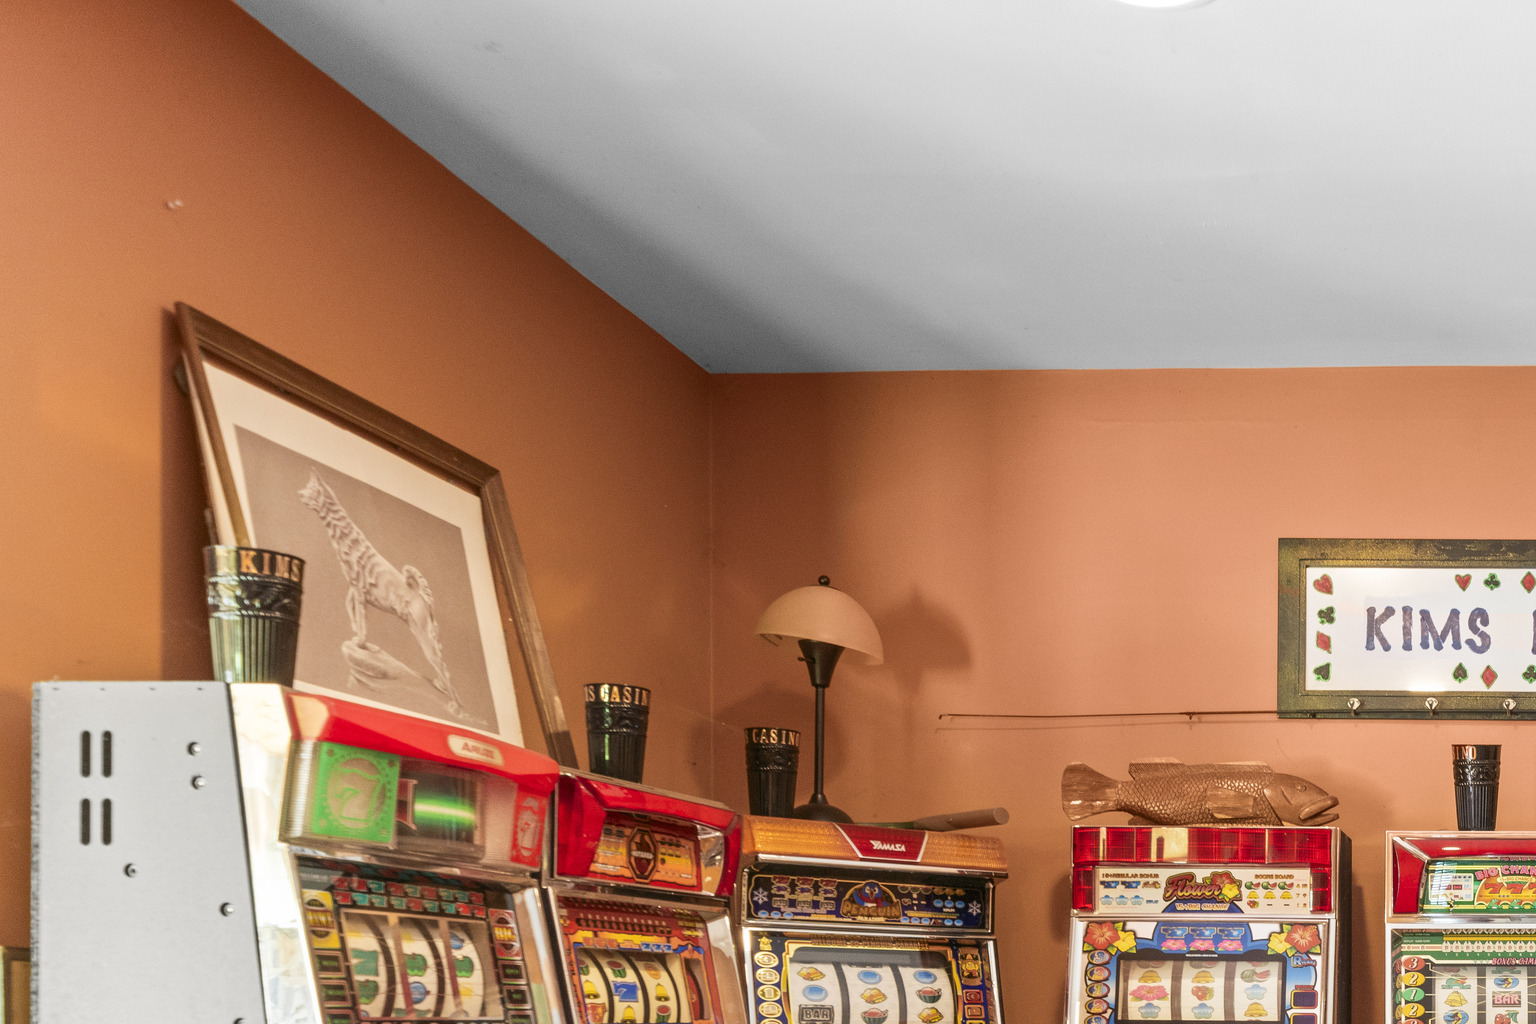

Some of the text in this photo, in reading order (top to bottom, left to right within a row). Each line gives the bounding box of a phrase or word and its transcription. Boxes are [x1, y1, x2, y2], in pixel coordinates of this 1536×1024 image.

[240, 550, 301, 582] KIMS
[1365, 605, 1492, 654] KIMS
[1474, 867, 1499, 881] BIG
[1165, 873, 1222, 898] Flower
[1408, 957, 1418, 969] 3
[1491, 957, 1517, 965] BONUS
[1409, 973, 1419, 985] 2
[1410, 989, 1417, 1000] 1
[1492, 994, 1520, 1005] BAR
[804, 1008, 831, 1020] BAR
[1408, 1004, 1418, 1016] 2
